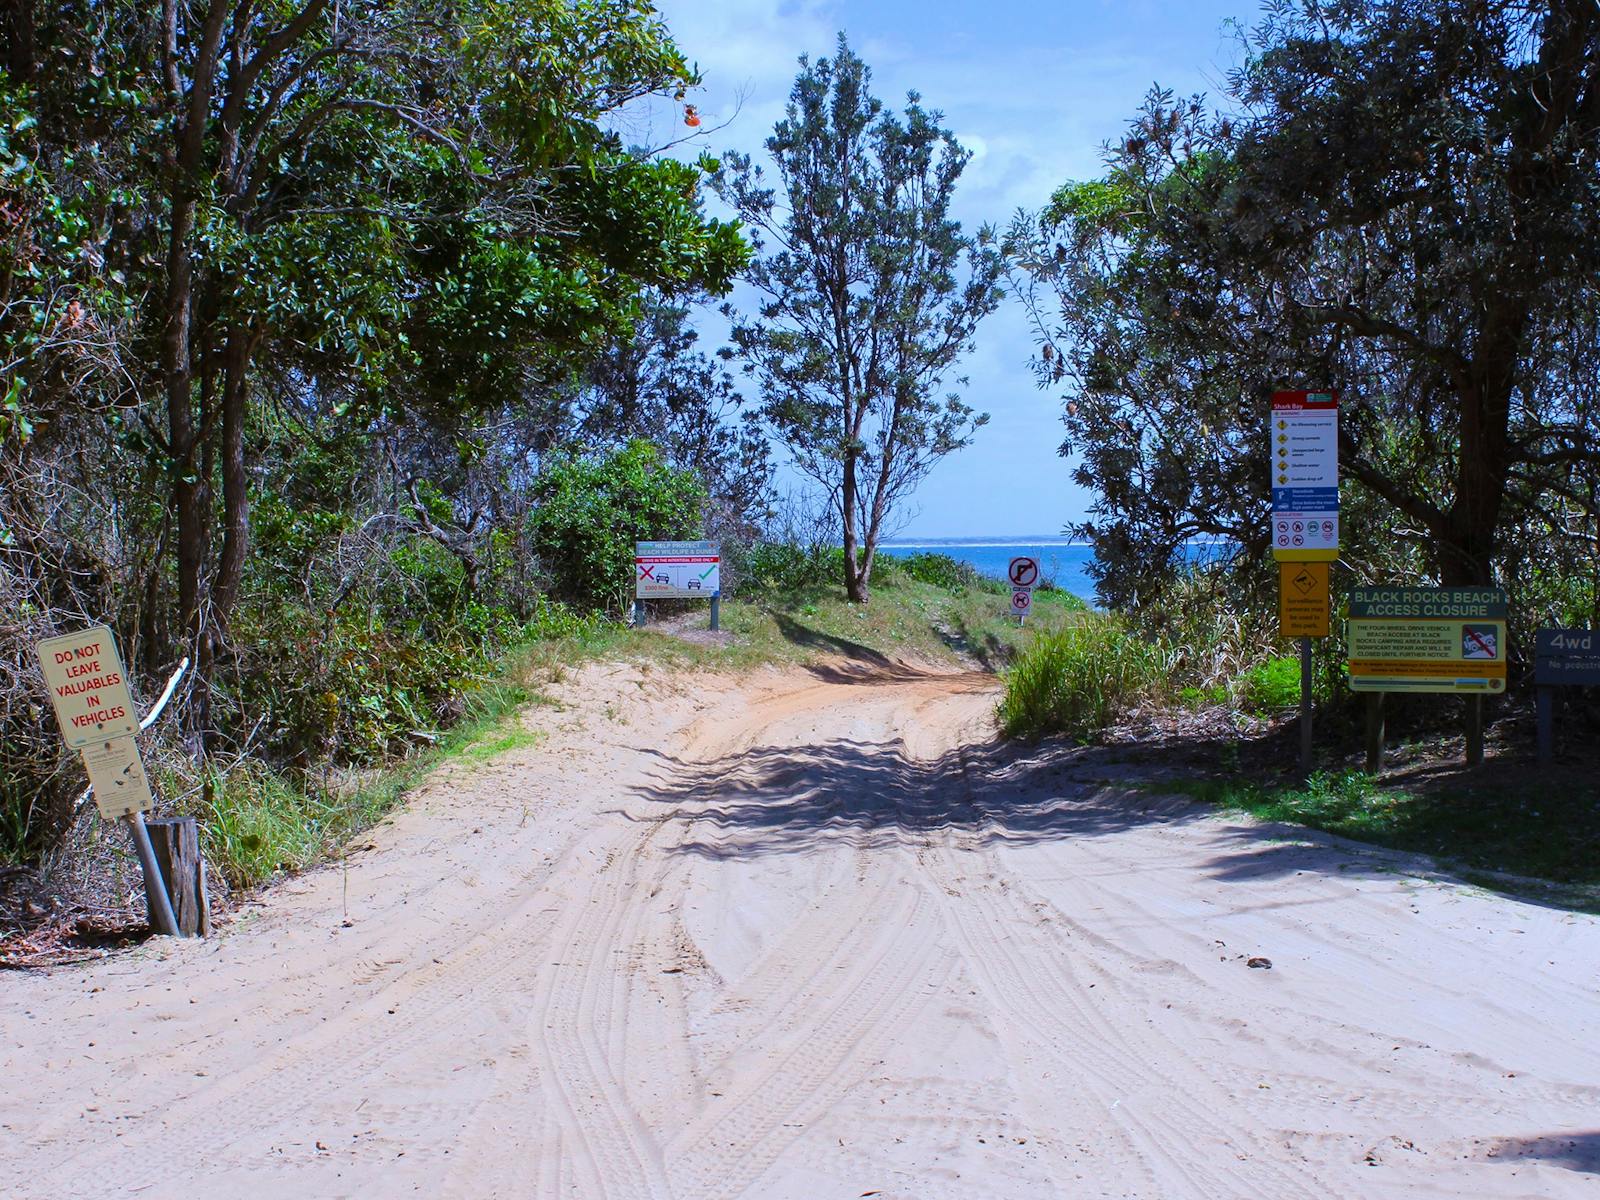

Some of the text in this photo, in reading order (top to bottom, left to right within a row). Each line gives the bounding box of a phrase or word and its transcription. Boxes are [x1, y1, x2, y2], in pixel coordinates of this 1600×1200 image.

[1355, 592, 1500, 603] BLACK ROCKS BEACH
[1366, 604, 1488, 616] ACCESS CLOSURE
[1550, 634, 1591, 649] 4wd
[55, 644, 100, 664] DO NOT
[66, 661, 100, 678] LEAVE
[56, 673, 120, 697] VALUABLES
[86, 695, 100, 708] IN
[72, 706, 125, 728] VEHICLES
